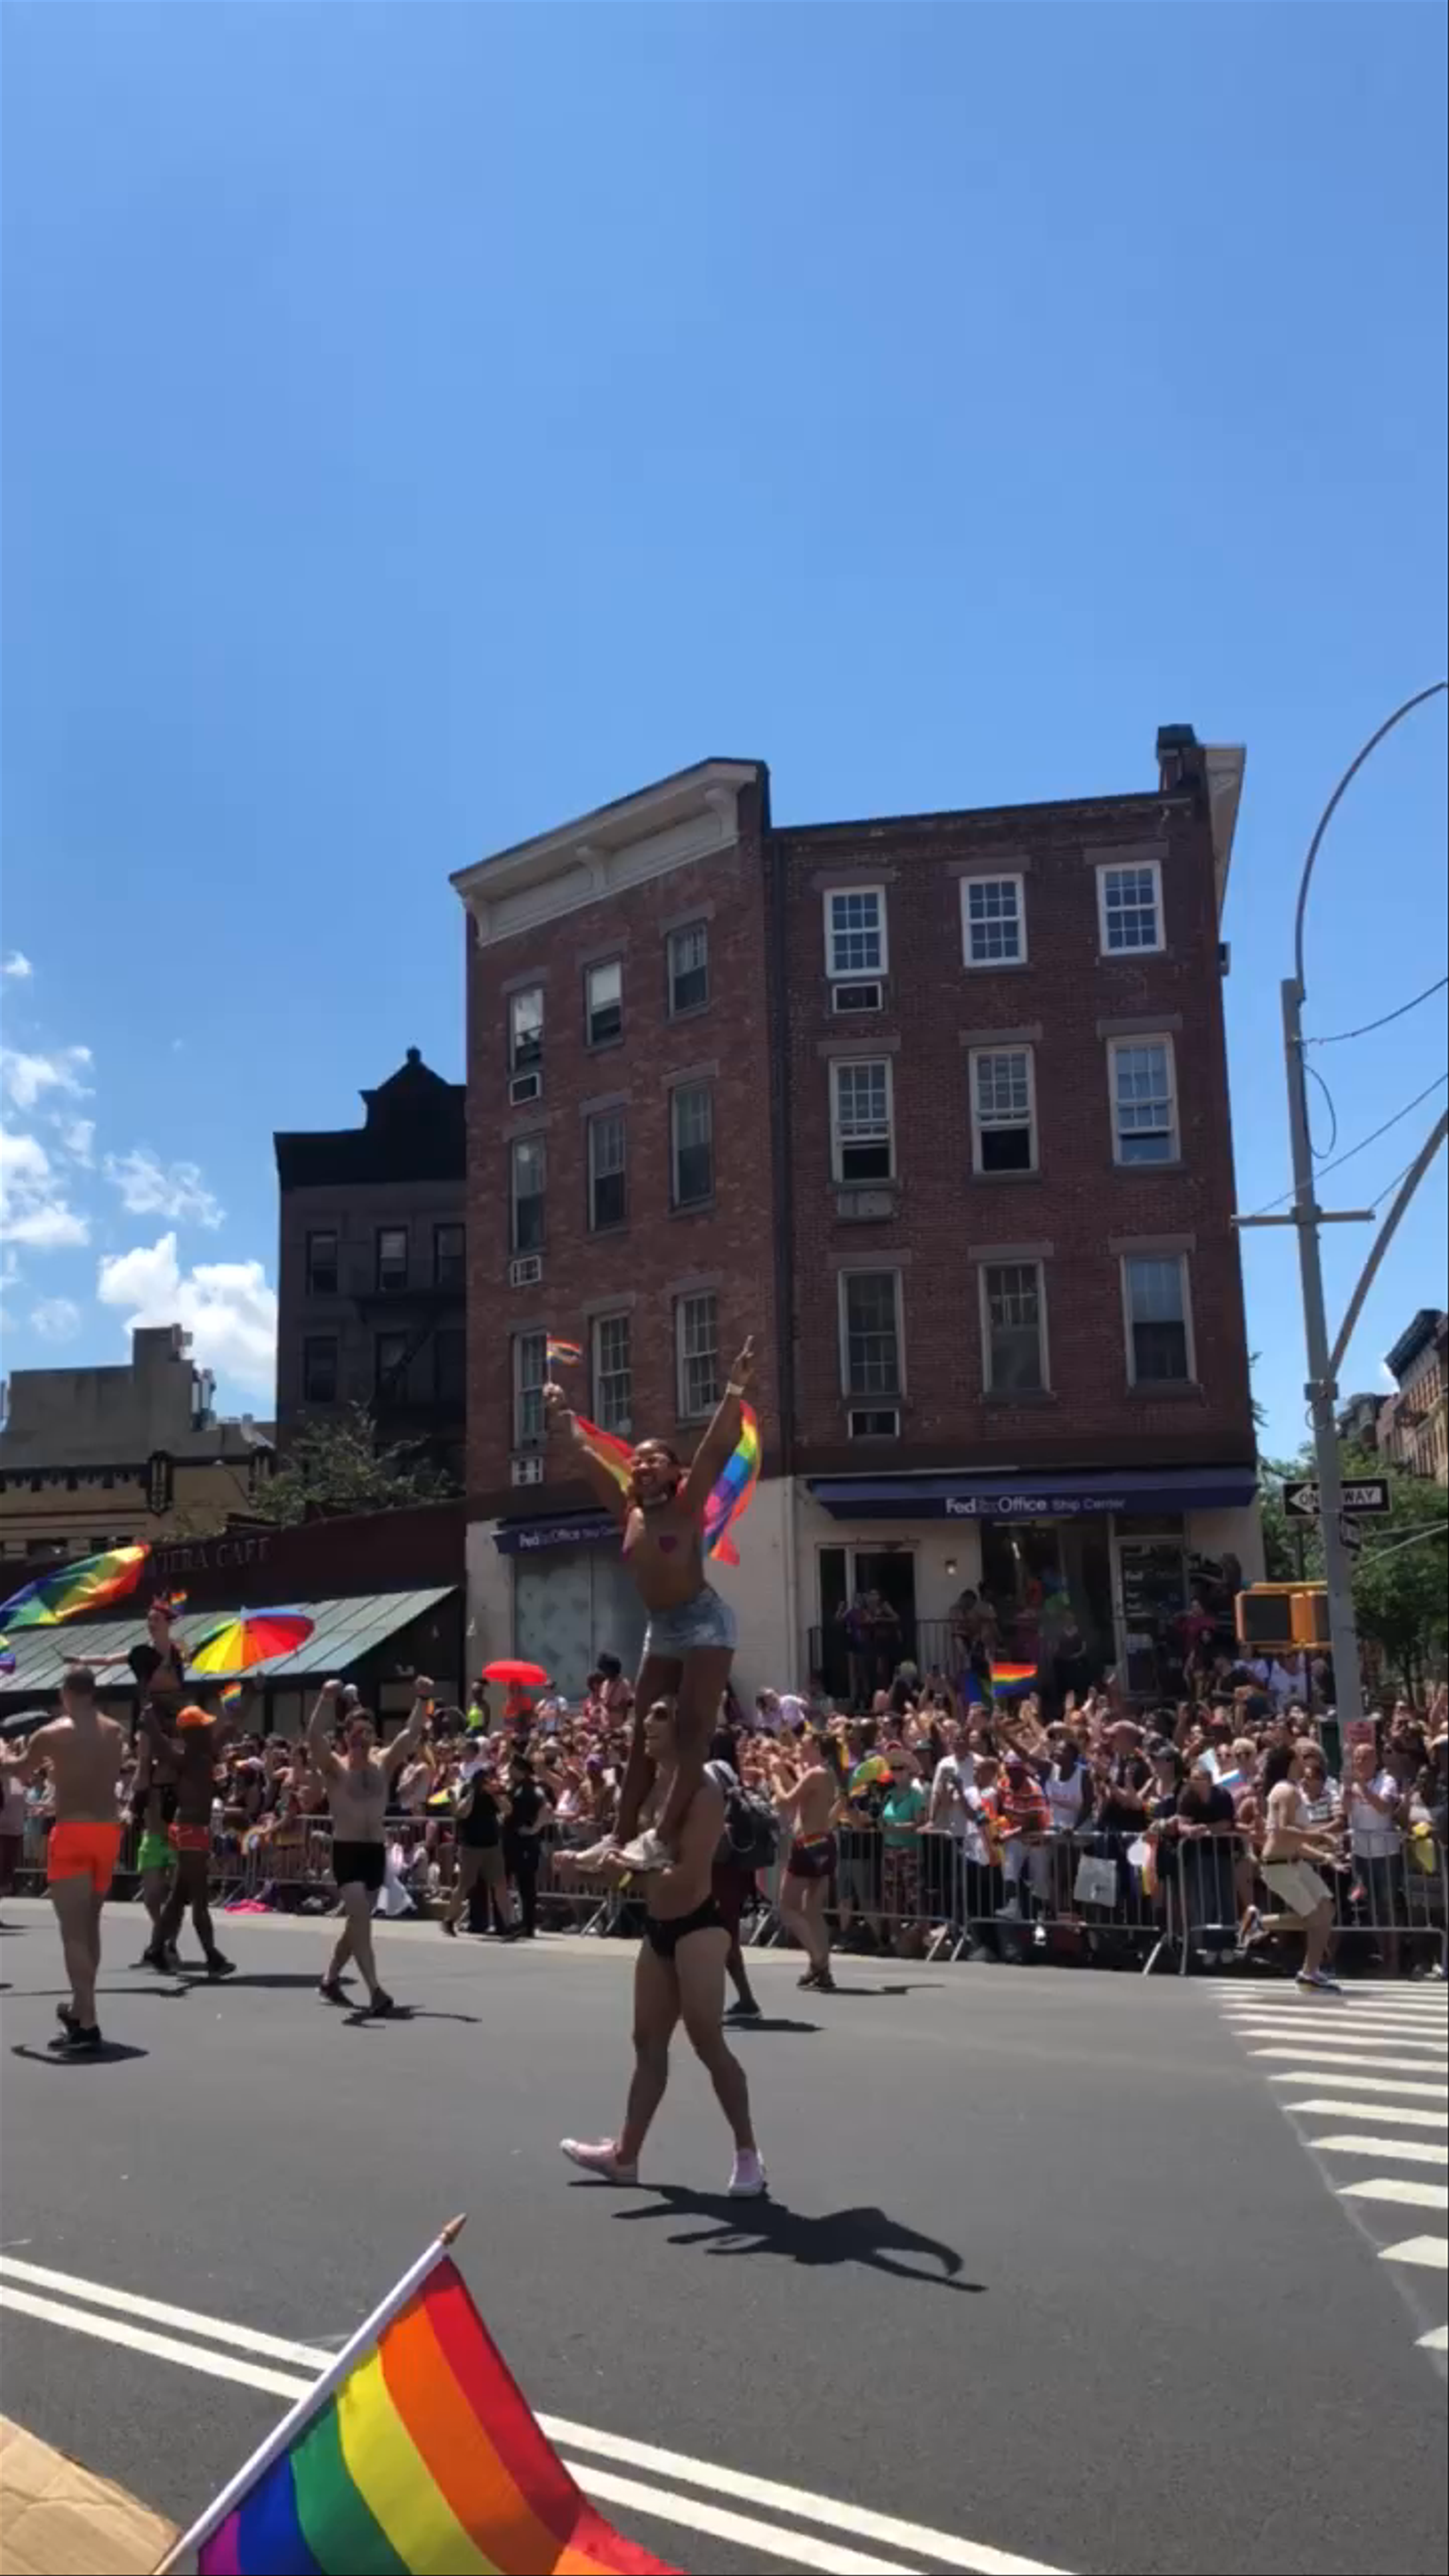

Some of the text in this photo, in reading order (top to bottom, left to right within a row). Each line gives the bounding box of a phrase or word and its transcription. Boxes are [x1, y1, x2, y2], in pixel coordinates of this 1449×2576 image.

[998, 1496, 1047, 1512] Office
[1299, 1490, 1374, 1506] ON WAY
